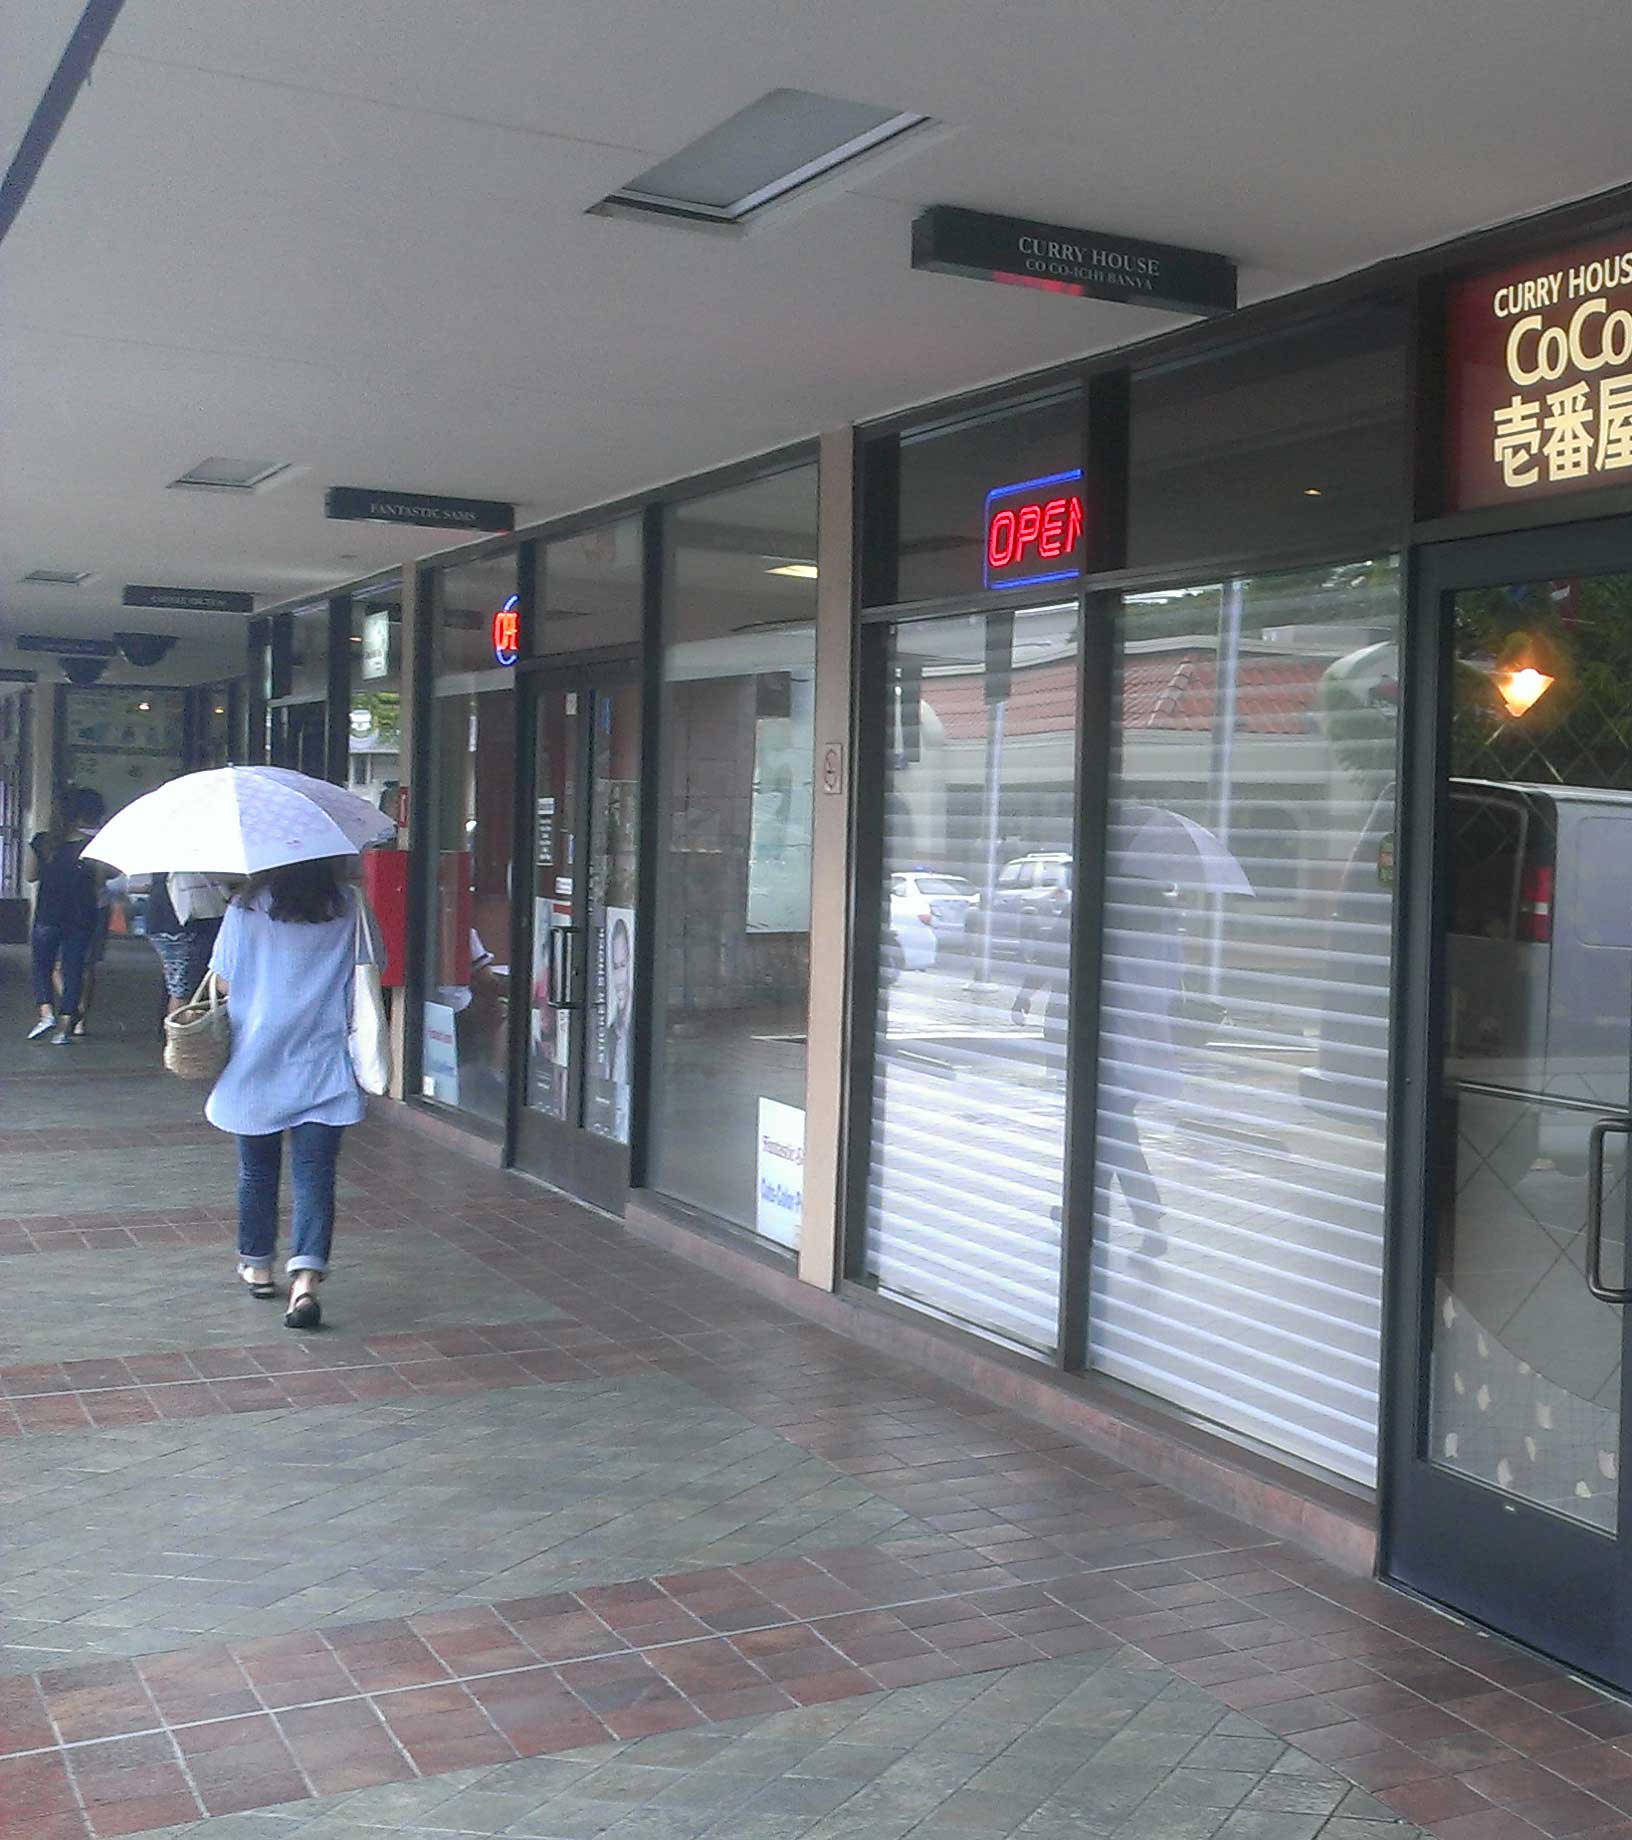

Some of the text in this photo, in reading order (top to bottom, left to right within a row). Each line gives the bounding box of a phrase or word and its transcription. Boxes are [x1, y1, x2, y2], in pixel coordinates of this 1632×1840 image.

[1018, 235, 1160, 277] CURRY HOUSE
[1026, 257, 1047, 273] CO
[1107, 272, 1154, 291] BANYA
[1494, 272, 1563, 318] CURRY
